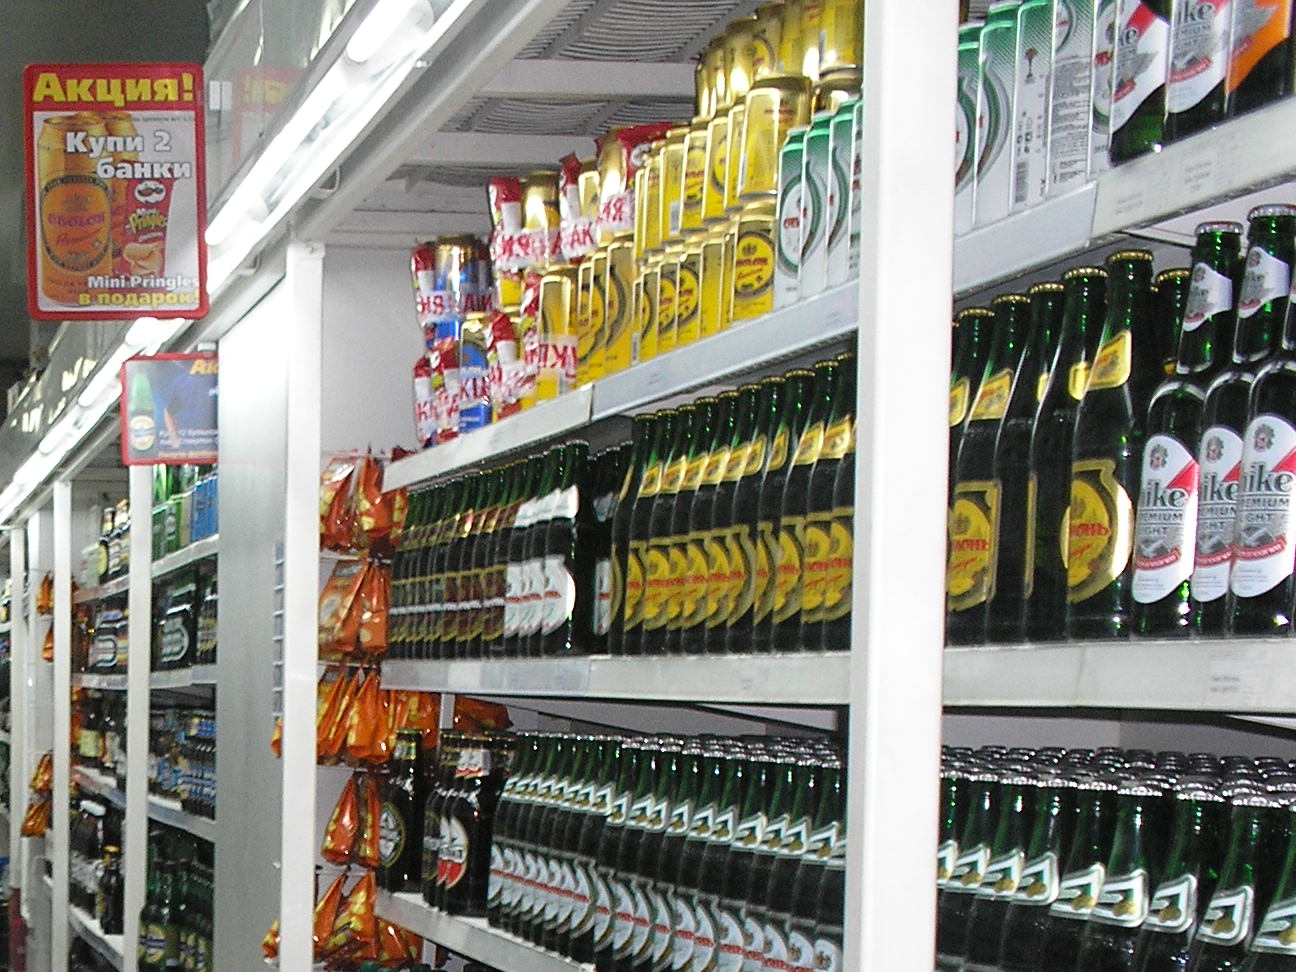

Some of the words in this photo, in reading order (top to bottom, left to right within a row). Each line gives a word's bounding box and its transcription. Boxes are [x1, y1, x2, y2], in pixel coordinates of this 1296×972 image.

[33, 73, 195, 107] Акция!
[66, 131, 144, 159] Купи
[154, 129, 172, 153] 2
[96, 157, 192, 179] банки
[87, 275, 125, 289] Mini
[130, 275, 199, 292] Pringles
[78, 292, 92, 307] в
